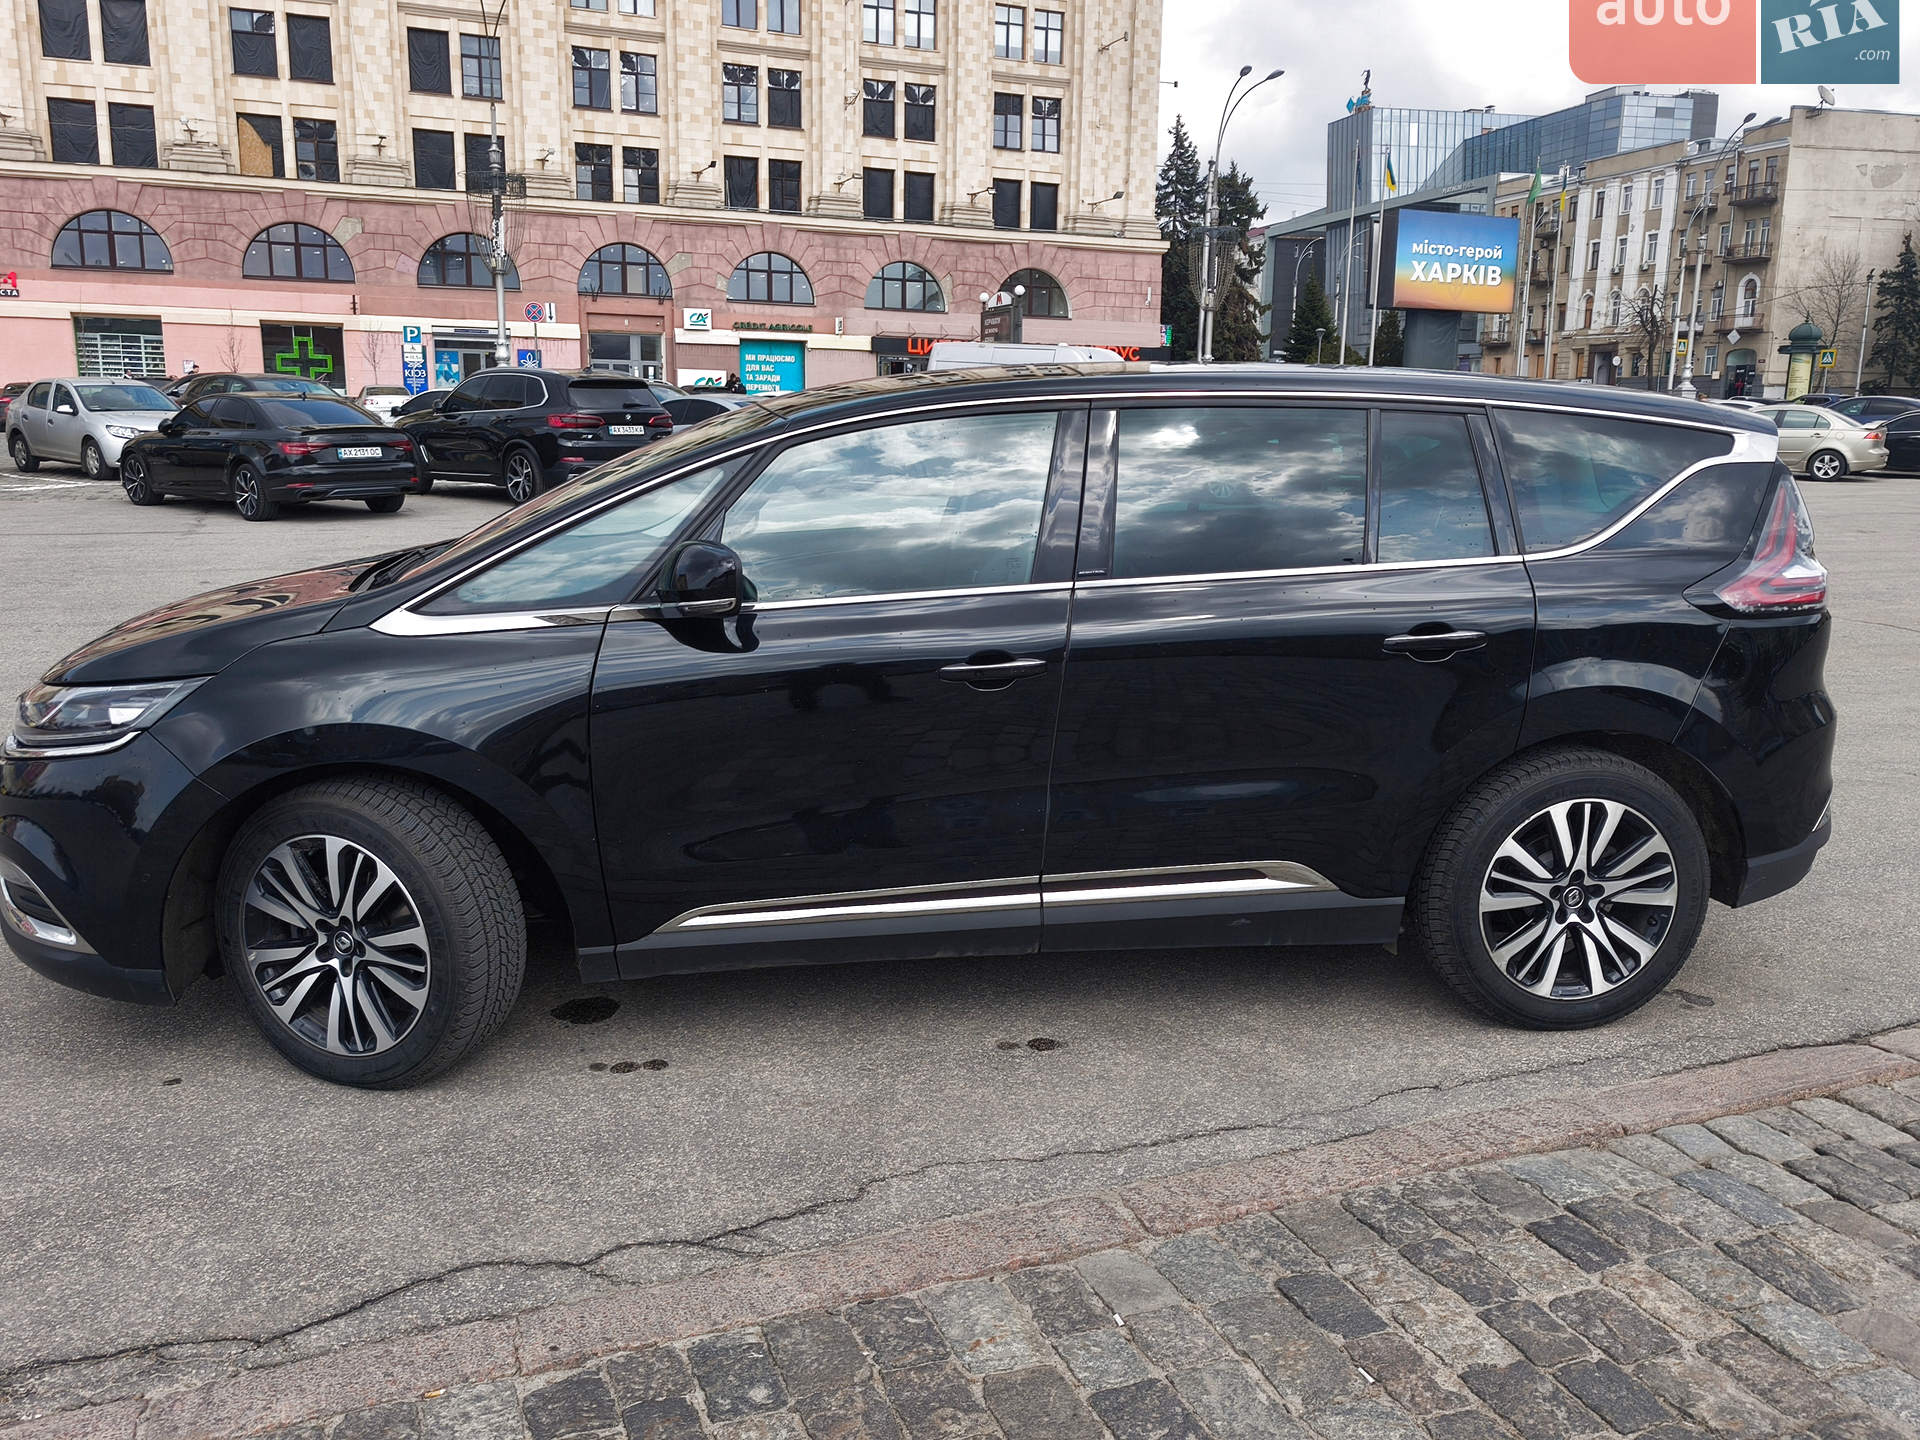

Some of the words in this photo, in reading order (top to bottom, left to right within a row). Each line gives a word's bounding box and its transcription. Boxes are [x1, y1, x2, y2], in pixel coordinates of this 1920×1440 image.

[1412, 239, 1502, 260] місто-герой
[1410, 260, 1502, 286] ХАРКІВ
[768, 322, 813, 332] AGRICOLE
[745, 354, 756, 362] МИ
[757, 355, 796, 364] ПРАЦЮЄМО
[745, 364, 760, 372] ДЛЯ
[761, 364, 775, 372] ВАС
[745, 373, 754, 381] ТА
[755, 374, 781, 382] ЗАРАДИ
[745, 383, 780, 392] ПЕРЕМОГИ
